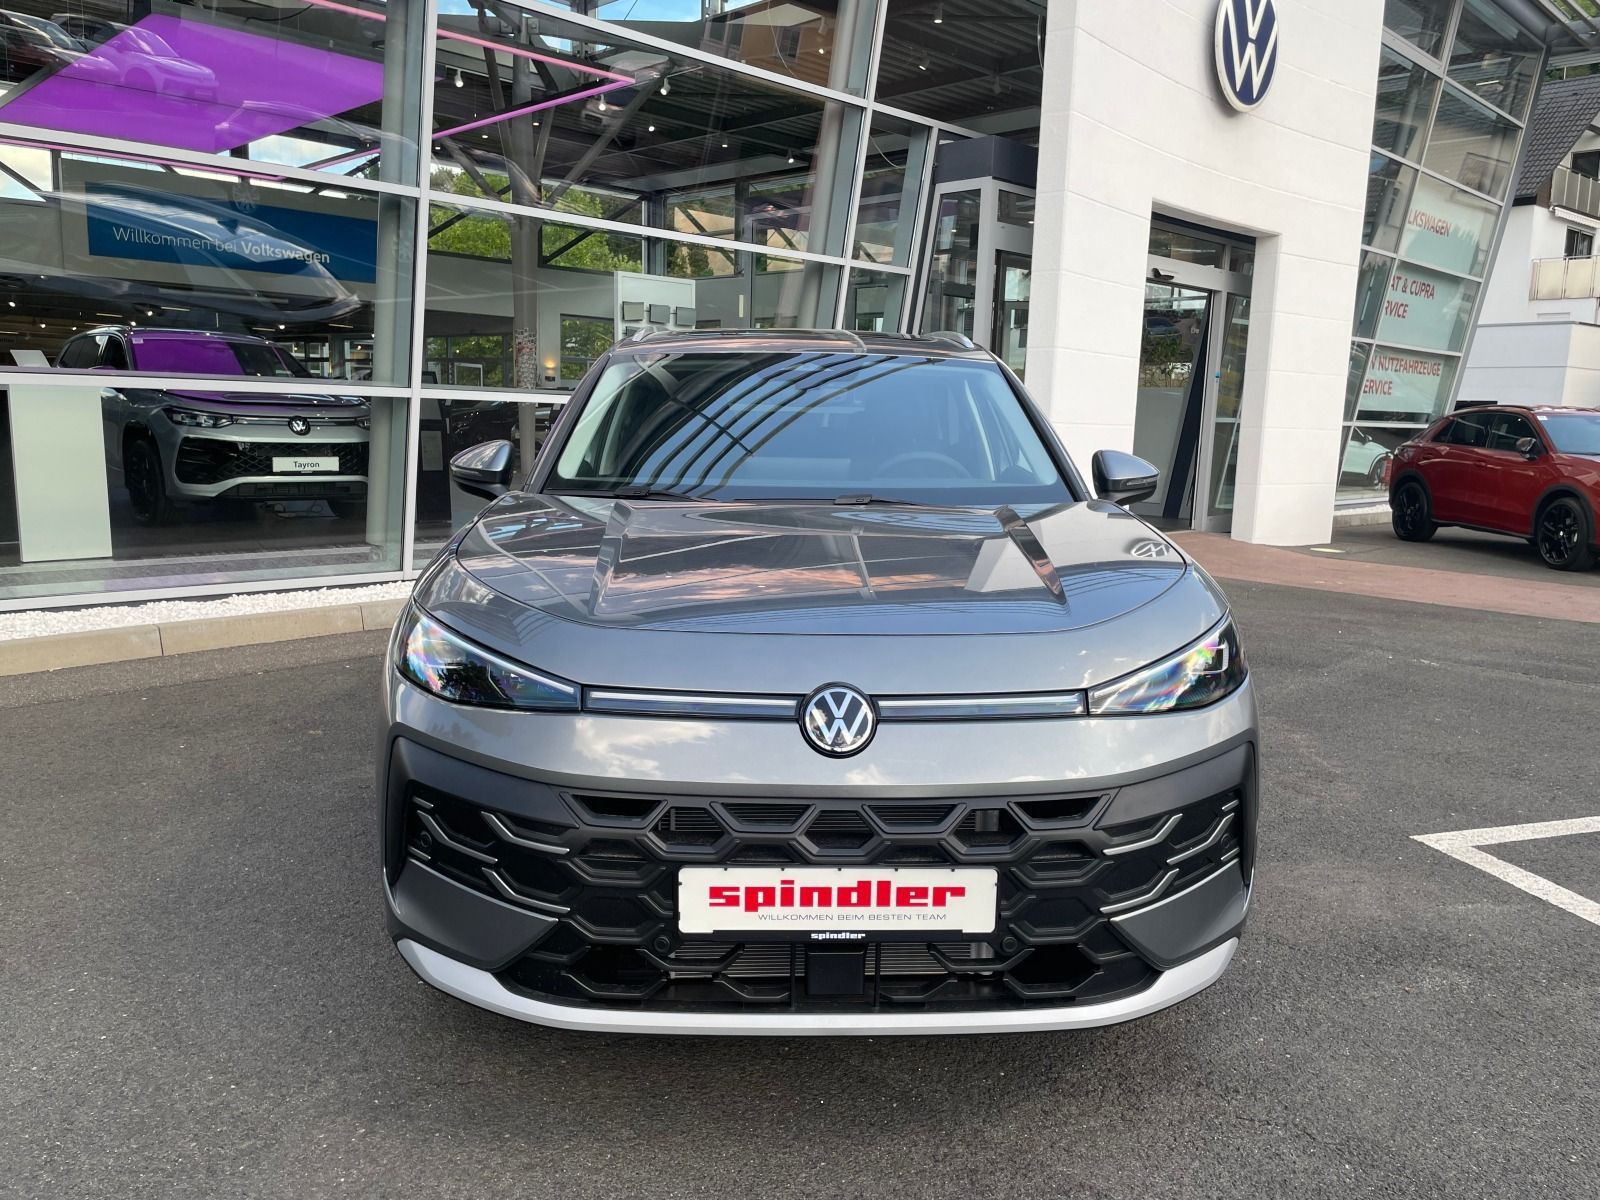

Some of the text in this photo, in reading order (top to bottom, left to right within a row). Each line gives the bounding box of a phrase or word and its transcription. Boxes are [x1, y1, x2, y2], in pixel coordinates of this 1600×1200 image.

[112, 225, 330, 264] Willkommen bei Volkswagen
[1401, 280, 1408, 294] &
[1409, 280, 1435, 300] CUPRA
[1378, 356, 1442, 377] NUTZFAHRZEUGE
[293, 461, 320, 469] Tayron
[709, 879, 966, 912] spindler
[758, 913, 947, 921] WILLKOMMEN BEIM BESTEN TEAM
[810, 931, 866, 940] spindler
